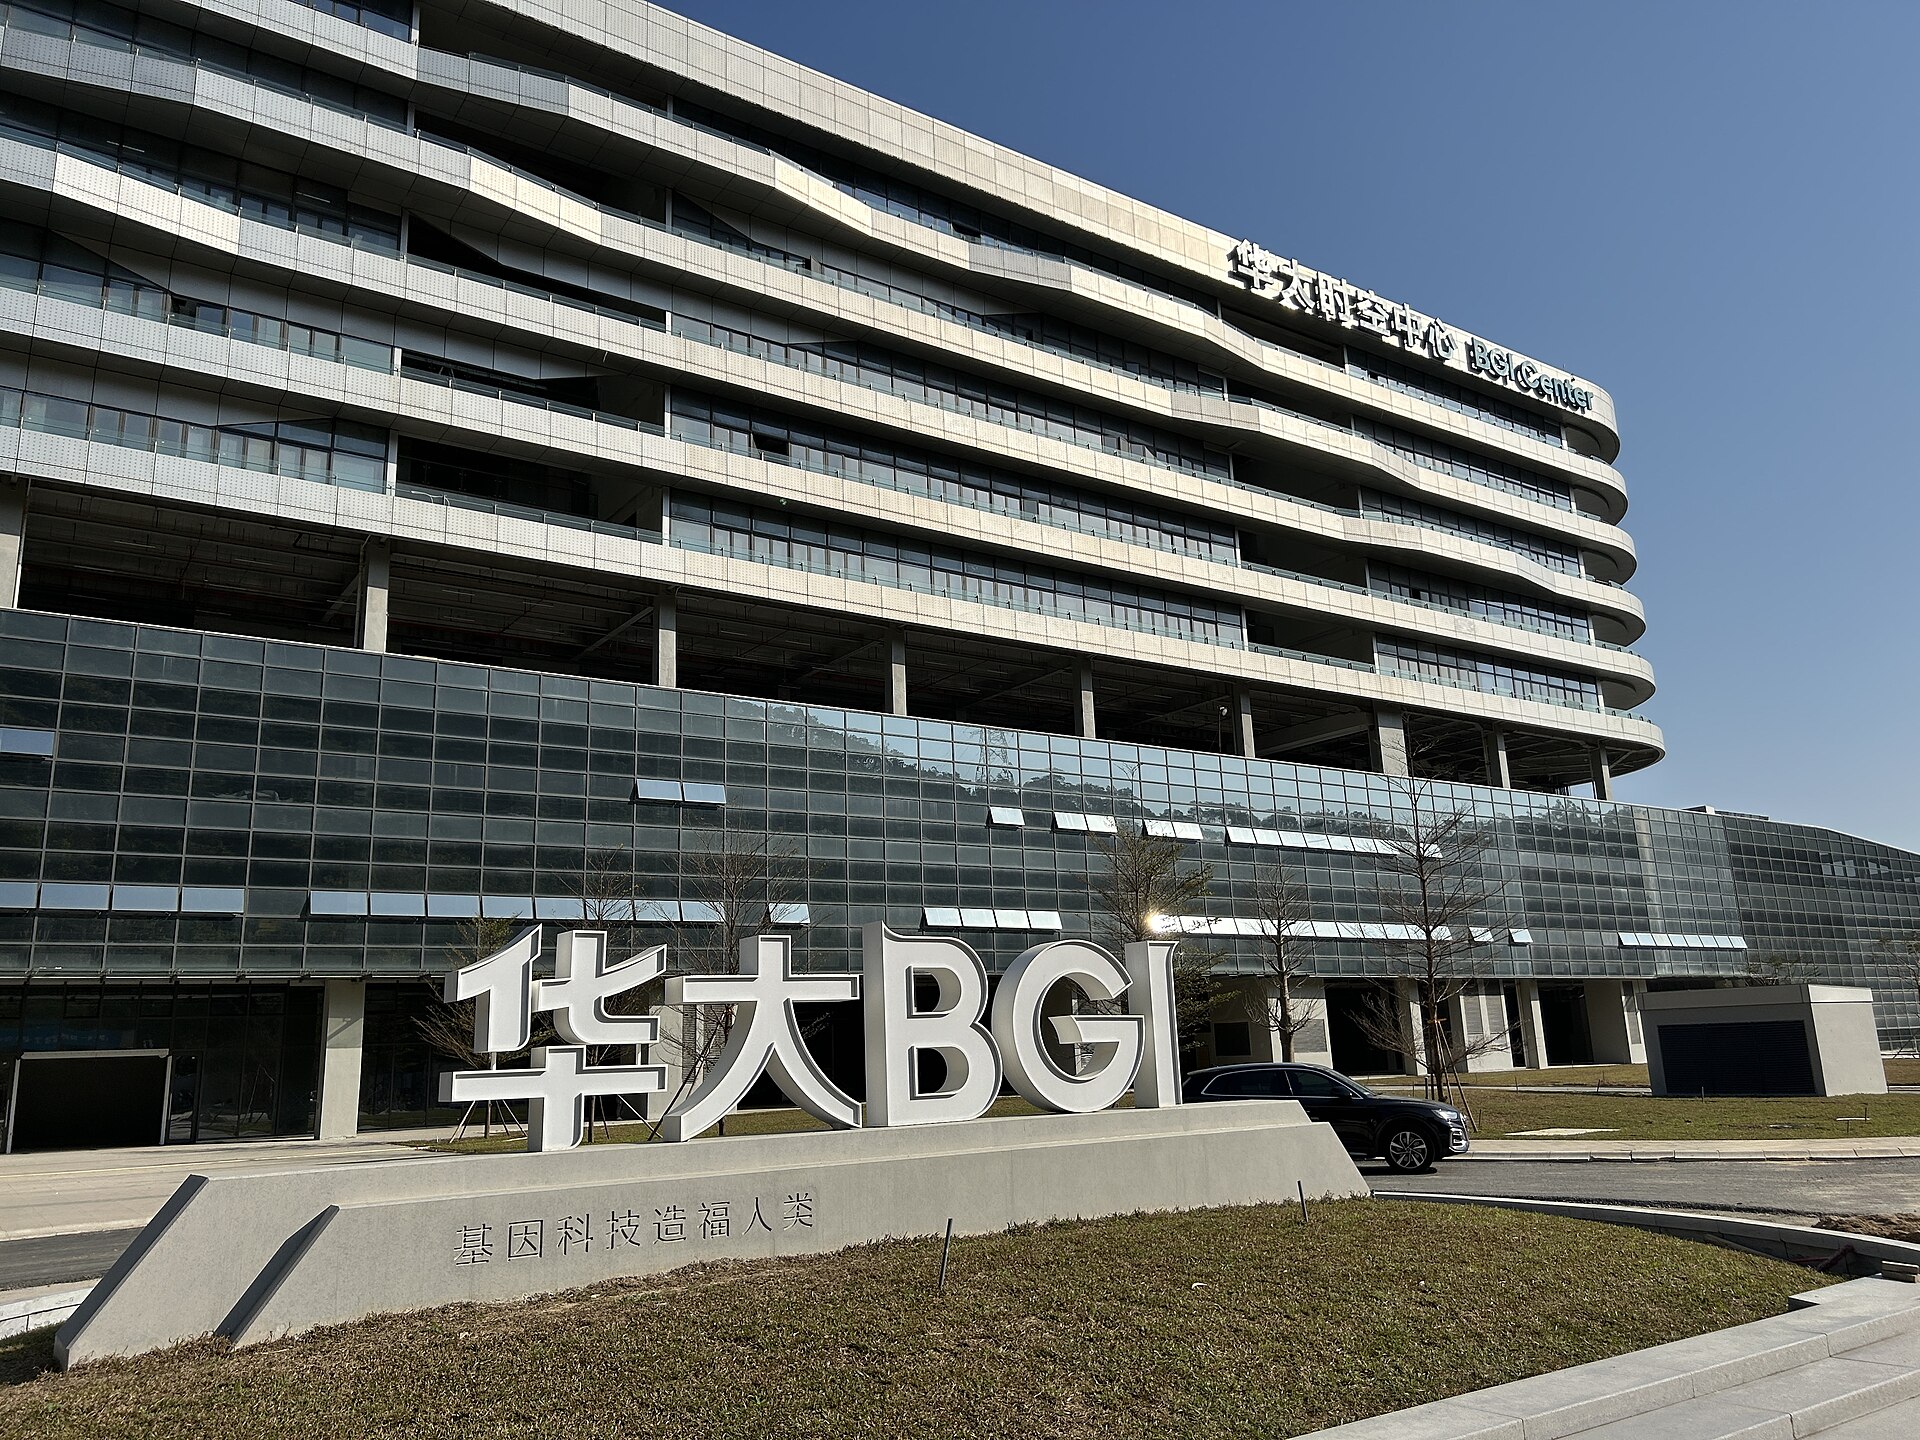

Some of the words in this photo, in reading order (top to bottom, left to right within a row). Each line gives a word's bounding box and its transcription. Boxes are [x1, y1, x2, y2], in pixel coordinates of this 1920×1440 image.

[1235, 238, 1458, 360] 华大时空中心
[1470, 337, 1515, 381] BGI
[1519, 360, 1594, 411] Center
[453, 1192, 814, 1266] 基因科技造福人类
